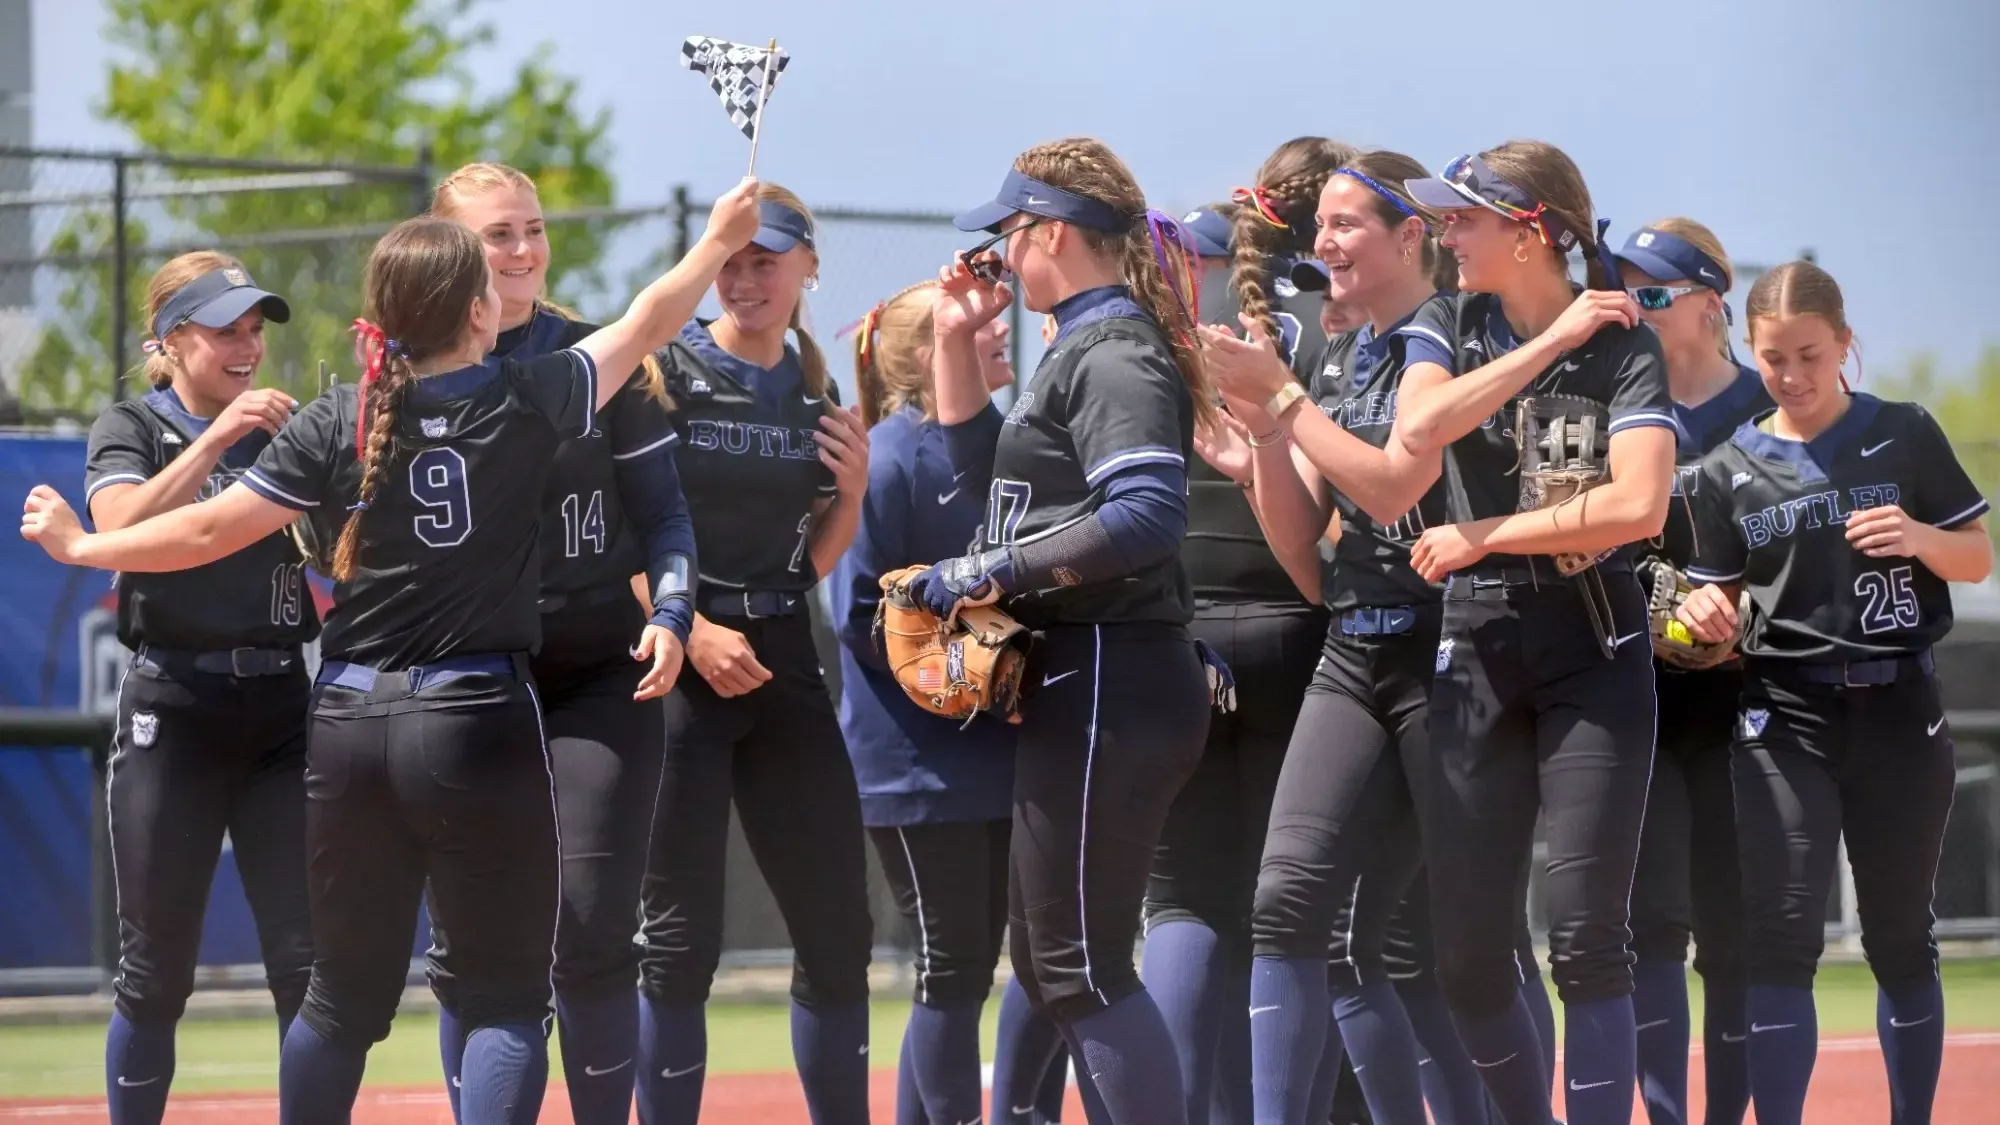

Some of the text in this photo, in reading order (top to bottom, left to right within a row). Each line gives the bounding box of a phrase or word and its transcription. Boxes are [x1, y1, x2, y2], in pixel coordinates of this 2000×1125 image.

[688, 420, 821, 461] BUTLE
[409, 446, 472, 547] 9
[562, 489, 605, 557] 14
[988, 478, 1032, 545] 17
[271, 563, 301, 625] 19
[1855, 566, 1919, 634] 25
